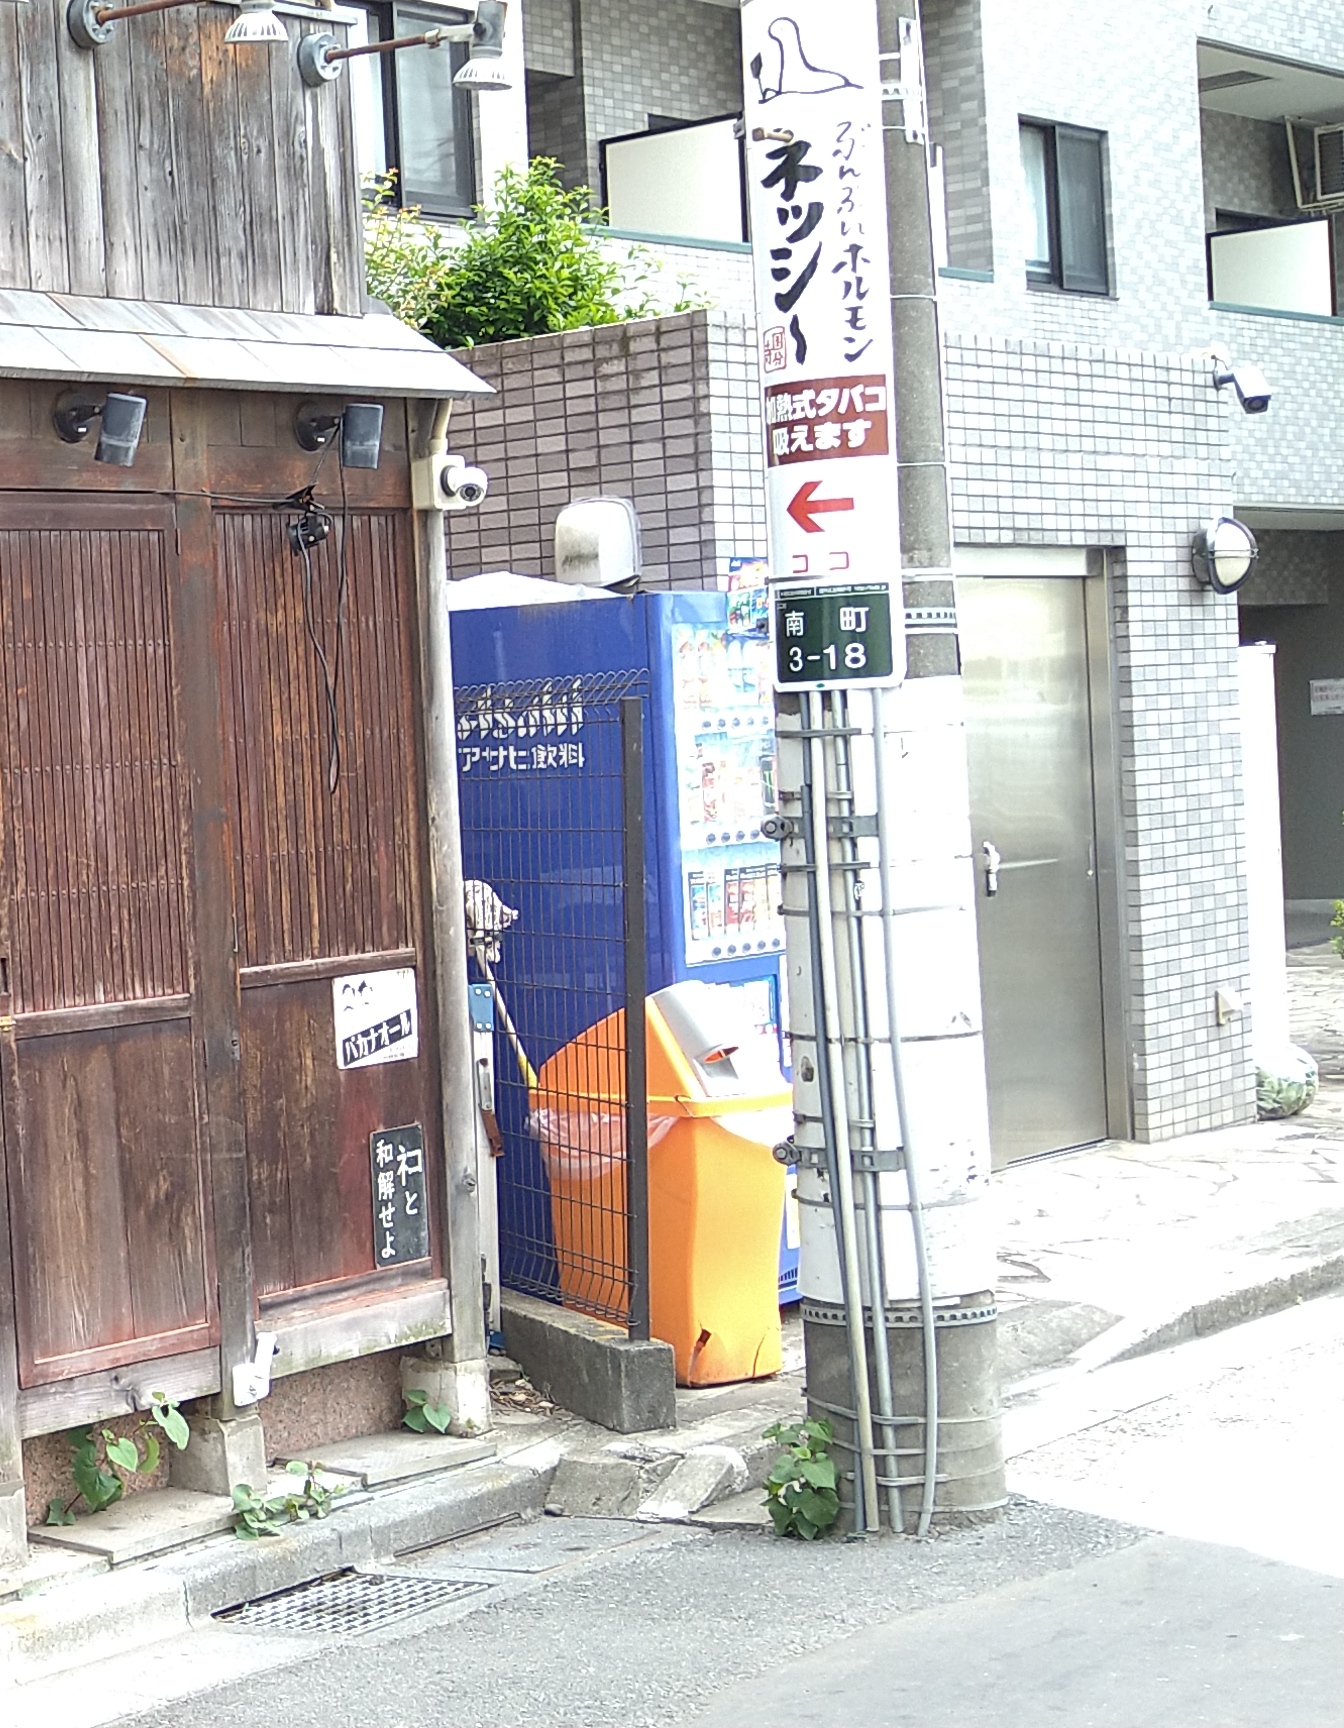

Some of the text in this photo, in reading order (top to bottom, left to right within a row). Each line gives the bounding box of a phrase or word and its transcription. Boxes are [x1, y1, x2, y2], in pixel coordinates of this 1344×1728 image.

[772, 418, 872, 456] 吸えます
[789, 642, 867, 672] 3-18
[458, 742, 585, 772] アサヒ飲料
[345, 1011, 411, 1063] バカナオール
[376, 1139, 396, 1259] 和解せよ
